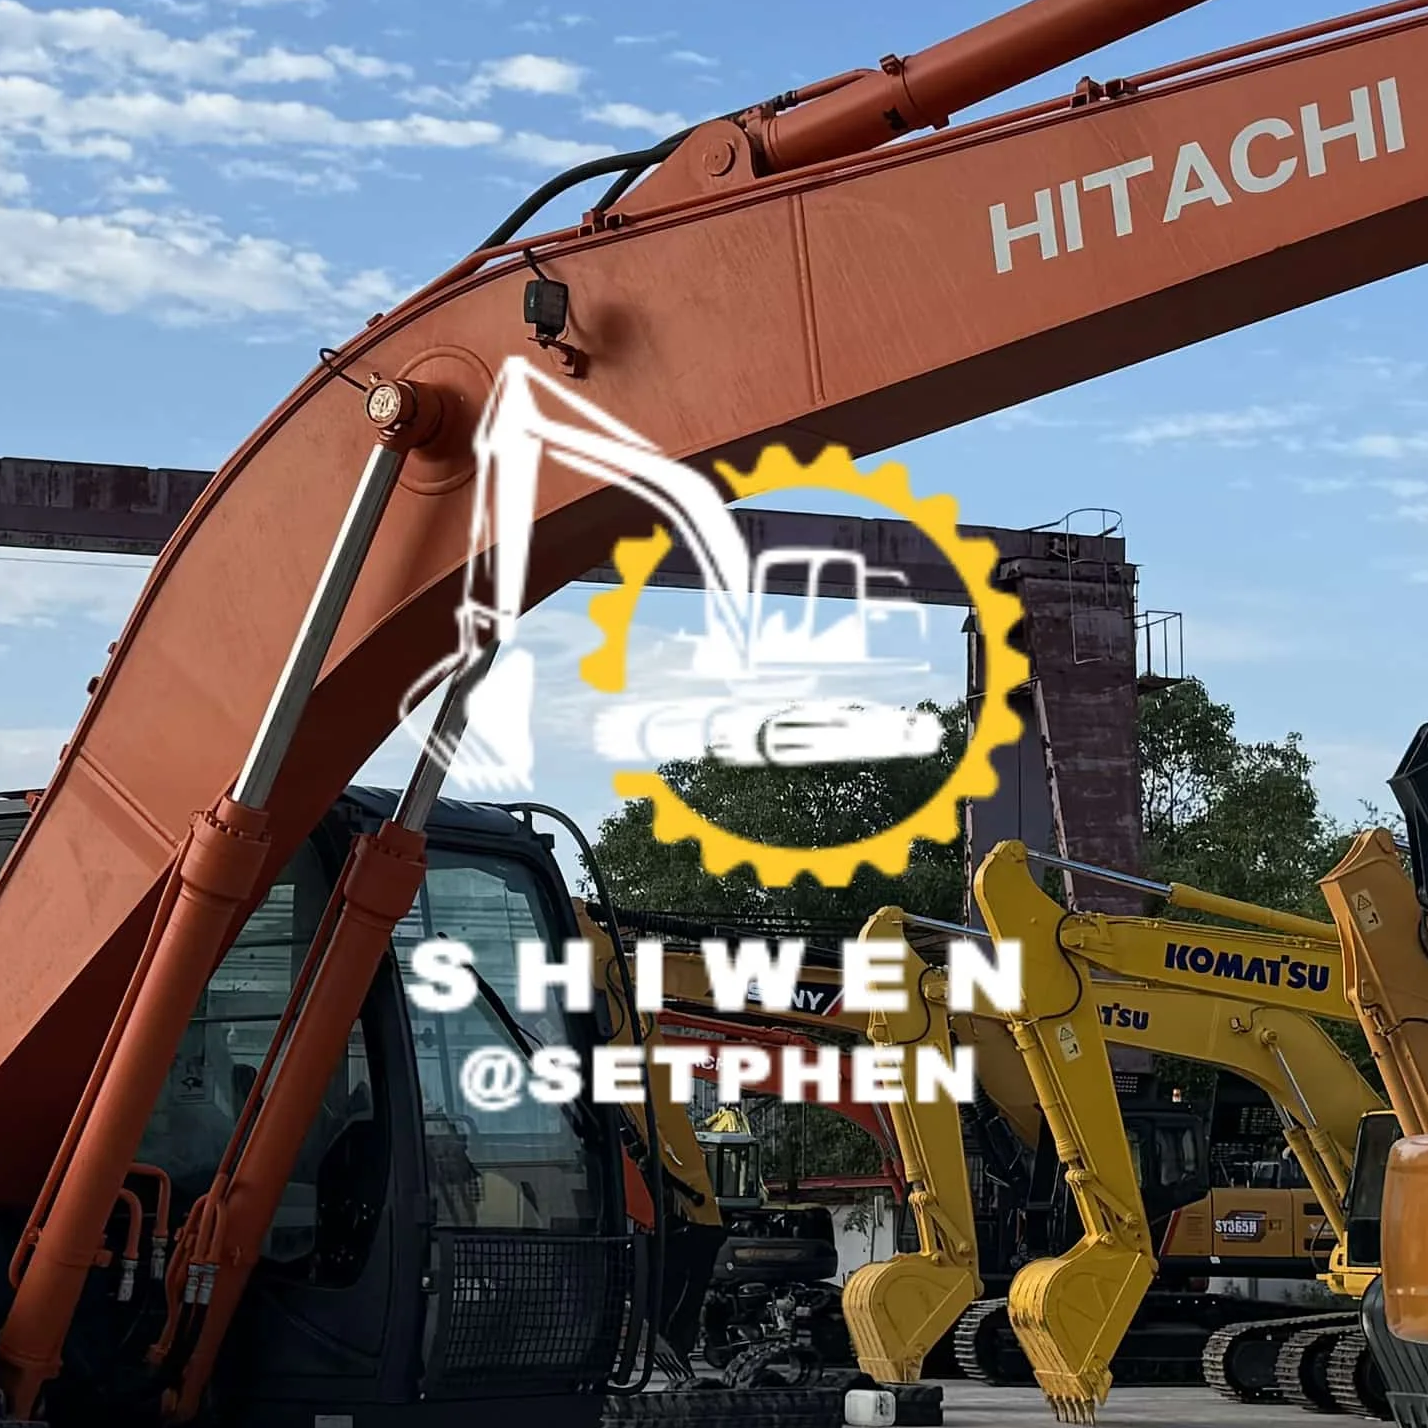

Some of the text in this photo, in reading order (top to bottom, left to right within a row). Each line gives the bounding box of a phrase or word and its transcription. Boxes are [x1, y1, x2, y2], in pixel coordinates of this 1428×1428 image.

[988, 76, 1406, 274] HITACHI
[1164, 943, 1330, 992] KOMATSU
[1096, 1002, 1149, 1030] TSU
